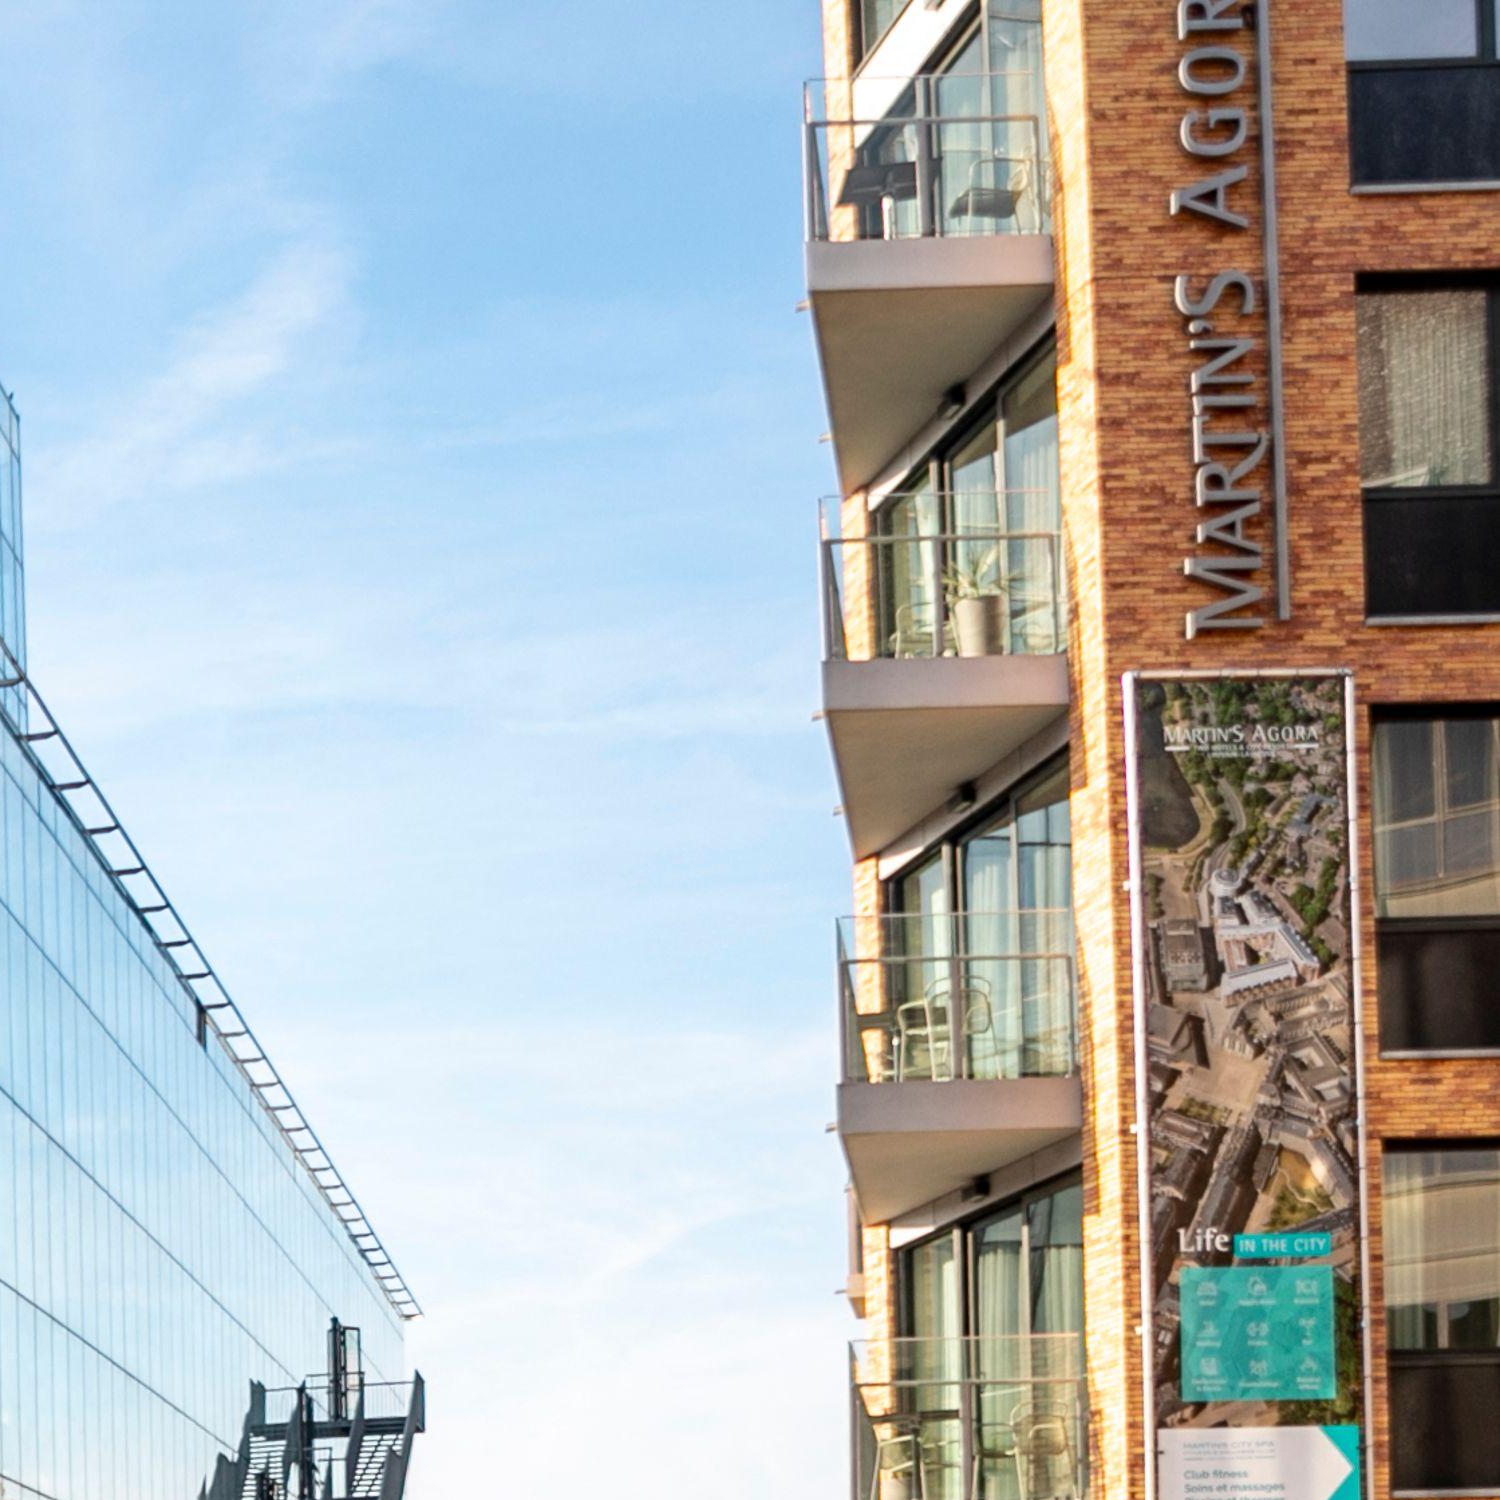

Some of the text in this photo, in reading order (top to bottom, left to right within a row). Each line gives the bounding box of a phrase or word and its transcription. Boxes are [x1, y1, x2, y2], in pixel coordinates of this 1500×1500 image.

[1174, 268, 1270, 641] MARTIN'S
[1163, 724, 1319, 744] MARTIN'S AGORA
[1176, 1226, 1327, 1253] Life IN THE CITY
[1183, 1468, 1248, 1480] Club fitness
[1183, 1482, 1286, 1494] Soins et massages
